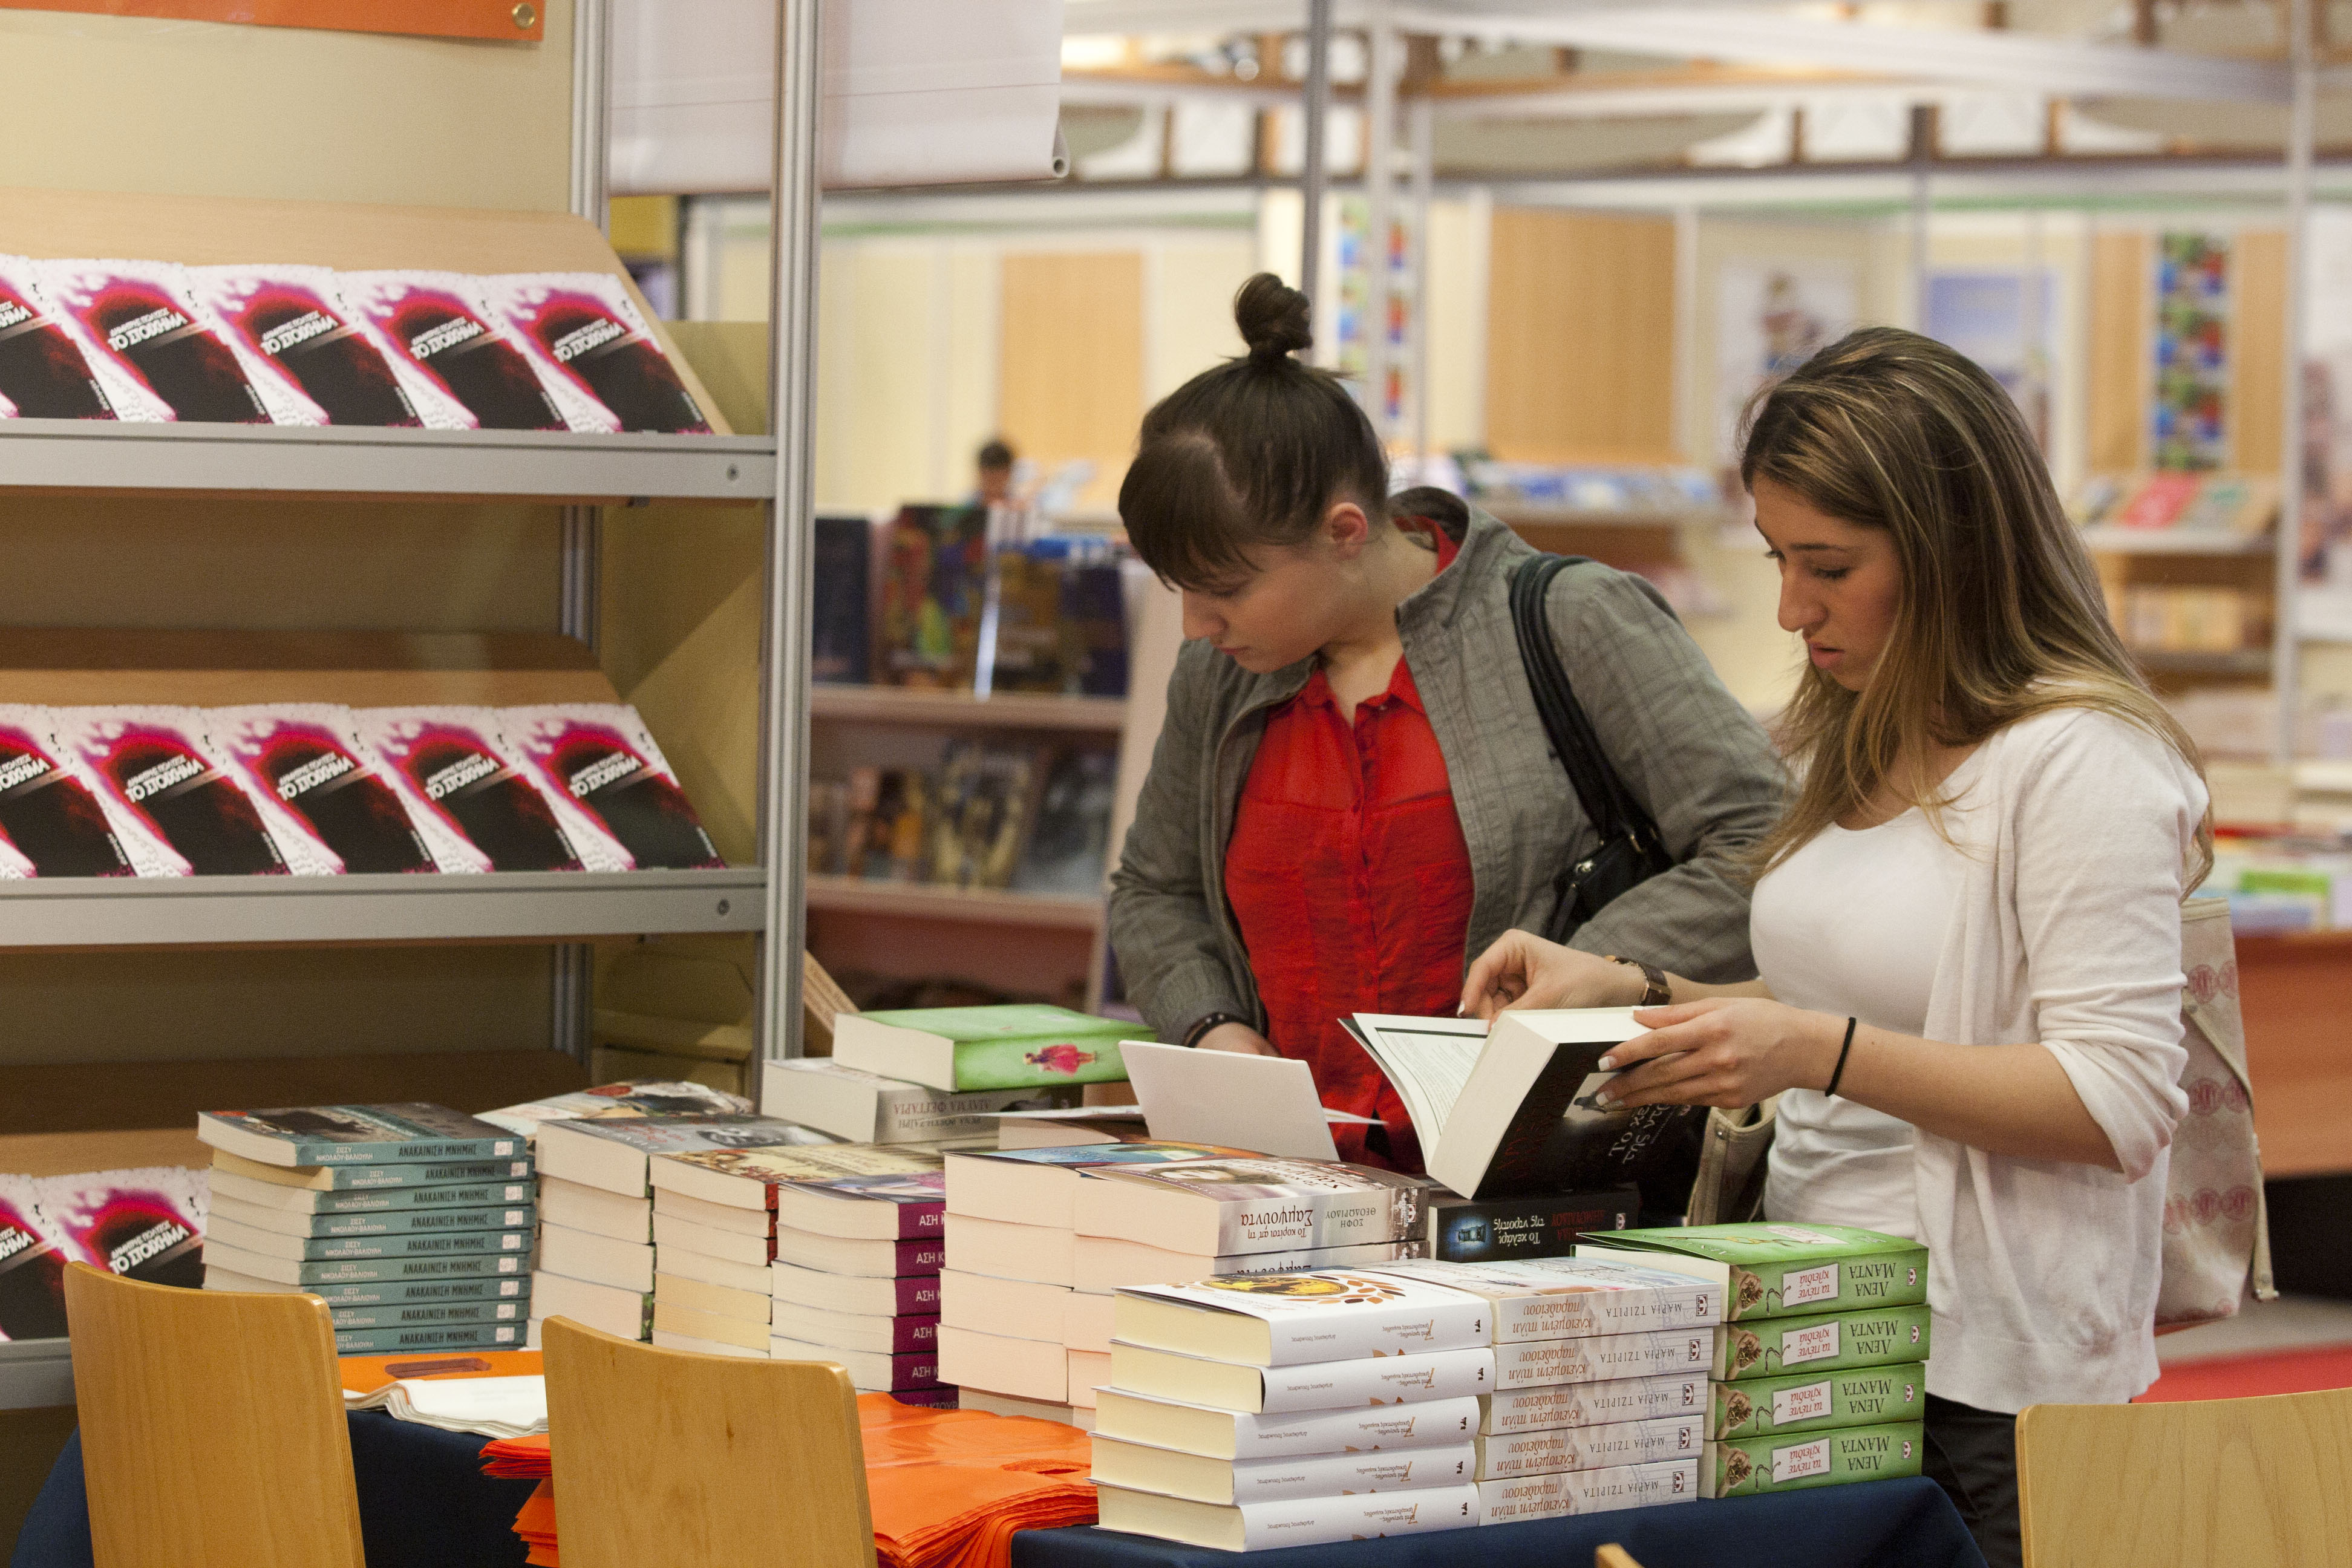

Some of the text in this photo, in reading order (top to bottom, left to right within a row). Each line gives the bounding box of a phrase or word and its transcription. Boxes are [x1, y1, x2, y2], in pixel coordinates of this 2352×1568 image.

[108, 334, 128, 352] ΤΟ
[261, 339, 281, 355] ΤΟ
[410, 342, 430, 360] ΤΟ
[554, 344, 573, 362] ΤΟ
[125, 785, 146, 802] ΤΟ
[278, 783, 298, 801] ΤΟ
[425, 783, 445, 800] ΤΟ
[569, 780, 589, 798] ΤΟ
[399, 1143, 477, 1157] ΑΝΑΚΑΙΝΙΣΗ ΜΝΗΜΗΣ
[1609, 1132, 1633, 1156] Το
[414, 1189, 489, 1203] ΑΝΑΚΑΙΝΙΣΗ ΜΝΗΜΗΣ
[920, 1215, 938, 1226] ΑΣΗ
[1241, 1204, 1313, 1230] Σαμψούντα
[1325, 1207, 1376, 1219] ΘΕΟΔΩΡΙΔΟΥ
[411, 1214, 488, 1228] ΑΝΑΚΑΙΝΙΣΗ ΜΝΗΜΗΣ
[1341, 1218, 1364, 1228] ΣΟΦΗ
[1492, 1218, 1529, 1233] ντροπής
[1530, 1215, 1546, 1228] της
[1270, 1226, 1296, 1238] κορίτσι
[1297, 1229, 1306, 1238] Το
[1529, 1232, 1540, 1245] Το
[109, 1258, 131, 1275] ΤΟ
[129, 1223, 189, 1267] ΣΤΟΙΧΗΜΑ
[408, 1237, 484, 1251] ΑΝΑΚΑΙΝΙΣΗ ΜΝΗΜΗΣ
[916, 1253, 935, 1264] ΑΣΗ
[403, 1261, 482, 1275] ΑΝΑΚΑΙΝΙΣΗ ΜΝΗΜΗΣ
[1849, 1263, 1896, 1279] ΜΑΝΤΑ
[1800, 1270, 1829, 1284] κλειδιά
[407, 1284, 483, 1298] ΑΝΑΚΑΙΝΙΣΗ ΜΝΗΜΗΣ
[916, 1290, 935, 1302] ΑΣΗ
[1798, 1284, 1830, 1298] τα πέντε
[1855, 1281, 1889, 1296] ΛΕΝΑ
[402, 1307, 479, 1321] ΑΝΑΚΑΙΝΙΣΗ ΜΝΗΜΗΣ
[1524, 1300, 1580, 1316] παραδείσου
[1606, 1304, 1682, 1318] ΜΑΡΙΑ ΤΖΙΡΙΤΑ
[1513, 1317, 1591, 1334] κλεισμένη πύλη
[1850, 1320, 1898, 1336] ΜΑΝΤΑ
[400, 1330, 477, 1344] ΑΝΑΚΑΙΝΙΣΗ ΜΝΗΜΗΣ
[913, 1328, 932, 1339] ΑΣΗ
[1799, 1329, 1829, 1343] κλειδιά
[1520, 1345, 1575, 1363] παραδείσου
[1798, 1343, 1831, 1357] τα πέντε
[1857, 1340, 1891, 1354] ΛΕΝΑ
[1601, 1348, 1674, 1363] ΜΑΡΙΑ ΤΖΙΡΙΤΑ
[912, 1367, 930, 1377] ΑΣΗ
[1509, 1363, 1586, 1380] κλεισμένη πύλη
[1791, 1387, 1821, 1401] κλειδιά
[1843, 1379, 1891, 1395] ΜΑΝΤΑ
[1513, 1392, 1568, 1410] παραδείσου
[1594, 1393, 1668, 1408] ΜΑΡΙΑ ΤΖΙΡΙΤΑ
[1849, 1398, 1884, 1413] ΛΕΝΑ
[1789, 1402, 1823, 1416] τα πέντε
[1501, 1410, 1579, 1426] κλεισμένη πύλη
[1508, 1437, 1564, 1454] παραδείσου
[1590, 1437, 1664, 1452] ΜΑΡΙΑ ΤΖΙΡΙΤΑ
[1841, 1436, 1889, 1452] ΜΑΝΤΑ
[1789, 1445, 1820, 1459] κλειδιά
[1497, 1454, 1575, 1474] κλεισμένη πύλη
[1789, 1459, 1822, 1474] τα πέντε
[1847, 1455, 1883, 1471] ΛΕΝΑ
[1502, 1483, 1558, 1500] παραδείσου
[1584, 1481, 1658, 1497] ΜΑΡΙΑ ΤΖΙΡΙΤΑ
[1492, 1499, 1569, 1520] κλεισμένη πύλη
